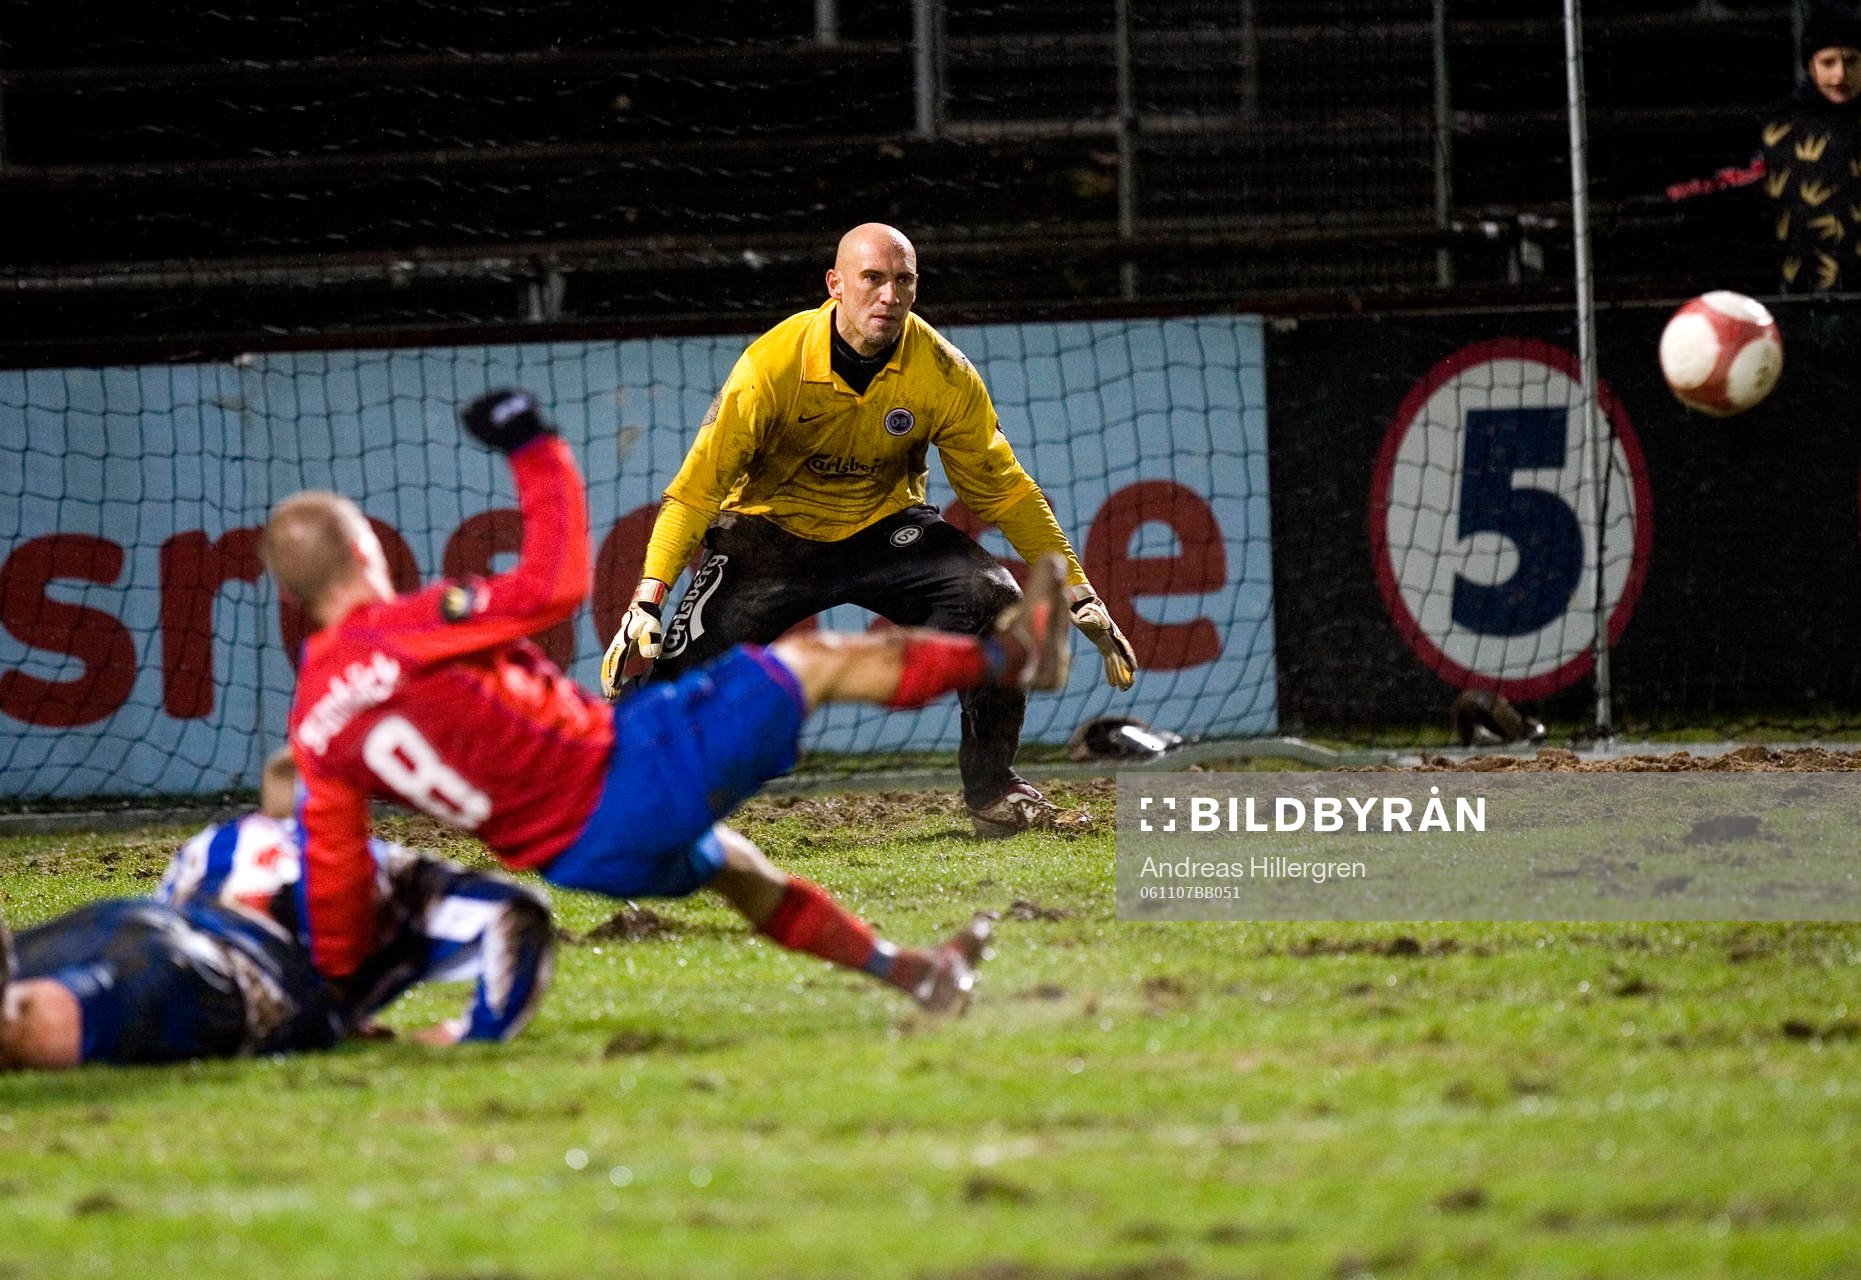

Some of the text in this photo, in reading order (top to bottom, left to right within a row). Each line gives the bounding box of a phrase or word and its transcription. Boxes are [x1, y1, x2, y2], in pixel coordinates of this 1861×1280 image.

[803, 453, 882, 479] Carlsber
[1452, 406, 1584, 637] 5
[657, 554, 729, 660] Carlsberg
[363, 714, 492, 830] 8
